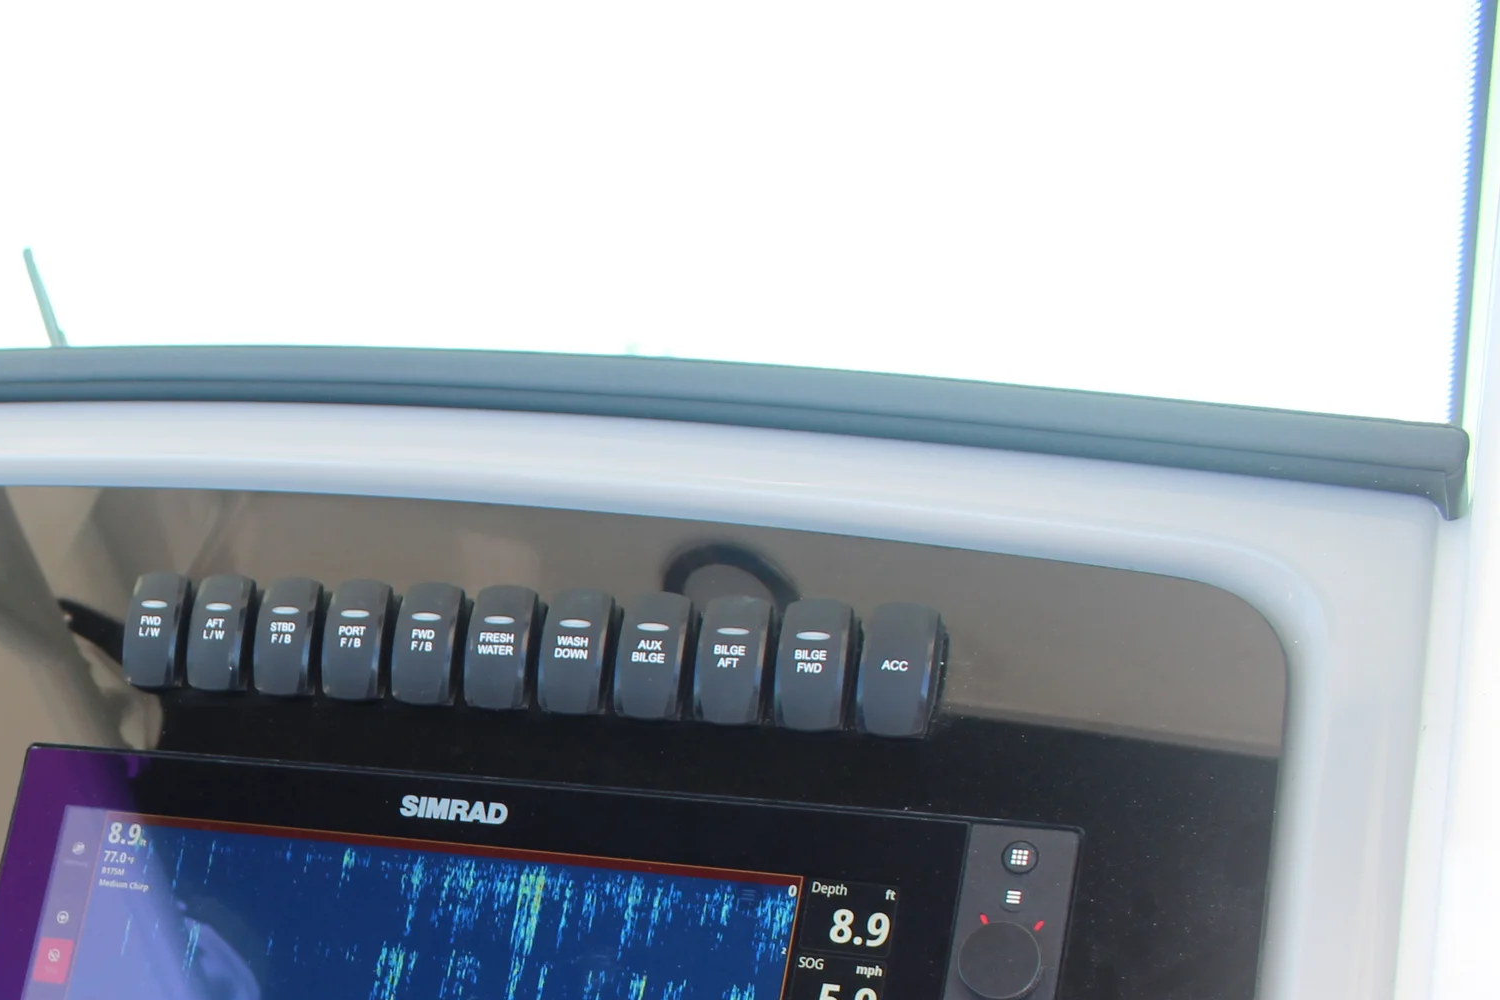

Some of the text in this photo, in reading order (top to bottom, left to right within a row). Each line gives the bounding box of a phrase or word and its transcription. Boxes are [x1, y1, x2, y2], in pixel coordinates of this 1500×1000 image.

[140, 615, 161, 627] FWD
[205, 618, 225, 629] AFT
[270, 621, 296, 633] STBD
[338, 625, 366, 637] PORT
[411, 628, 435, 640] FWD
[479, 632, 514, 644] FRESH
[557, 635, 589, 648] WASH
[477, 644, 514, 657] WATER
[637, 640, 663, 652] AUX
[713, 644, 746, 657] BILGE
[554, 647, 588, 660] DOWN
[631, 651, 666, 664] BILGE
[794, 649, 827, 661] BILGE
[716, 656, 740, 669] AFT
[796, 661, 822, 674] FWD
[881, 659, 909, 672] ACC
[399, 794, 509, 825] SIMRAD
[108, 822, 142, 846] 8.9
[104, 850, 127, 864] 77.0
[99, 878, 149, 893] Medium Chirp
[811, 881, 897, 901] Depth ft
[828, 908, 891, 948] 8.9
[781, 947, 787, 955] 2
[798, 956, 883, 979] SOG mph
